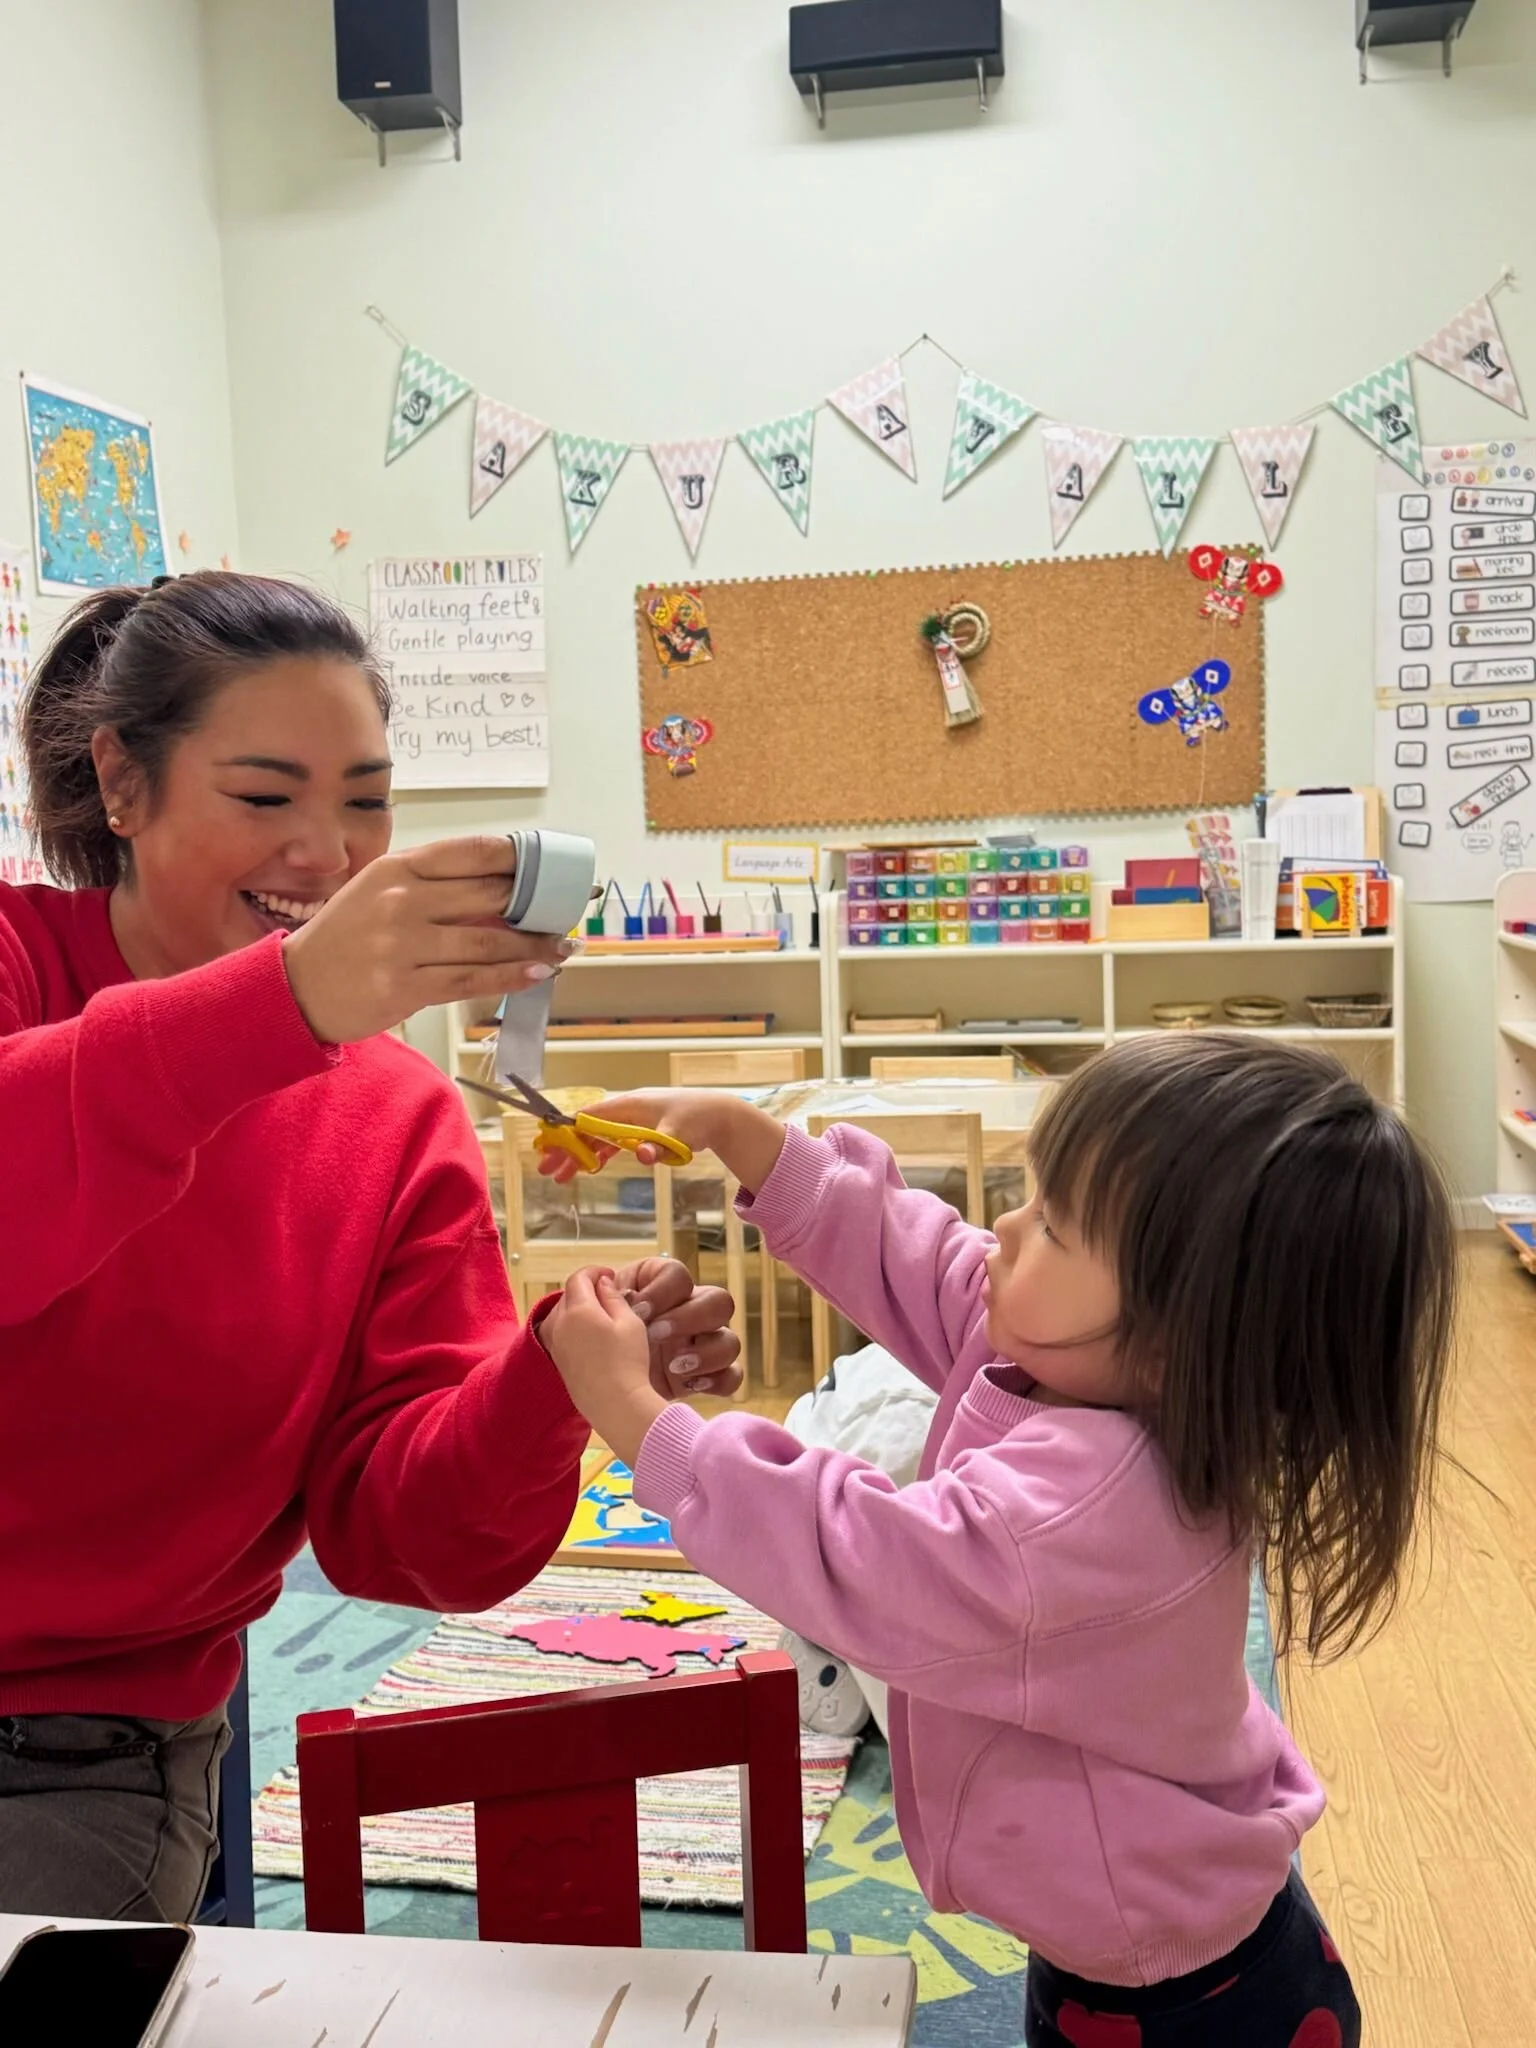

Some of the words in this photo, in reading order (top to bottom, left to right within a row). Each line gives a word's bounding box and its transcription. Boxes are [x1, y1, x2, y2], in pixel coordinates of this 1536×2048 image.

[1485, 493, 1525, 508] arrival
[1484, 555, 1525, 567] morning
[384, 560, 477, 587] CLASSROOM
[485, 558, 538, 585] RULES
[1487, 591, 1524, 606] snack
[387, 597, 472, 626] Walking
[479, 591, 526, 620] feet
[1475, 624, 1529, 637] restroom
[388, 628, 446, 652] Gentle
[457, 628, 534, 652] playing
[469, 672, 513, 684] voice
[1486, 664, 1530, 678] recess
[426, 693, 493, 720] Kind
[1487, 705, 1519, 719] lunch
[388, 723, 422, 760] Try
[436, 731, 473, 758] my
[484, 722, 542, 748] best!
[734, 856, 780, 871] Language
[782, 856, 804, 869] Arts
[1339, 876, 1353, 926] phonics
